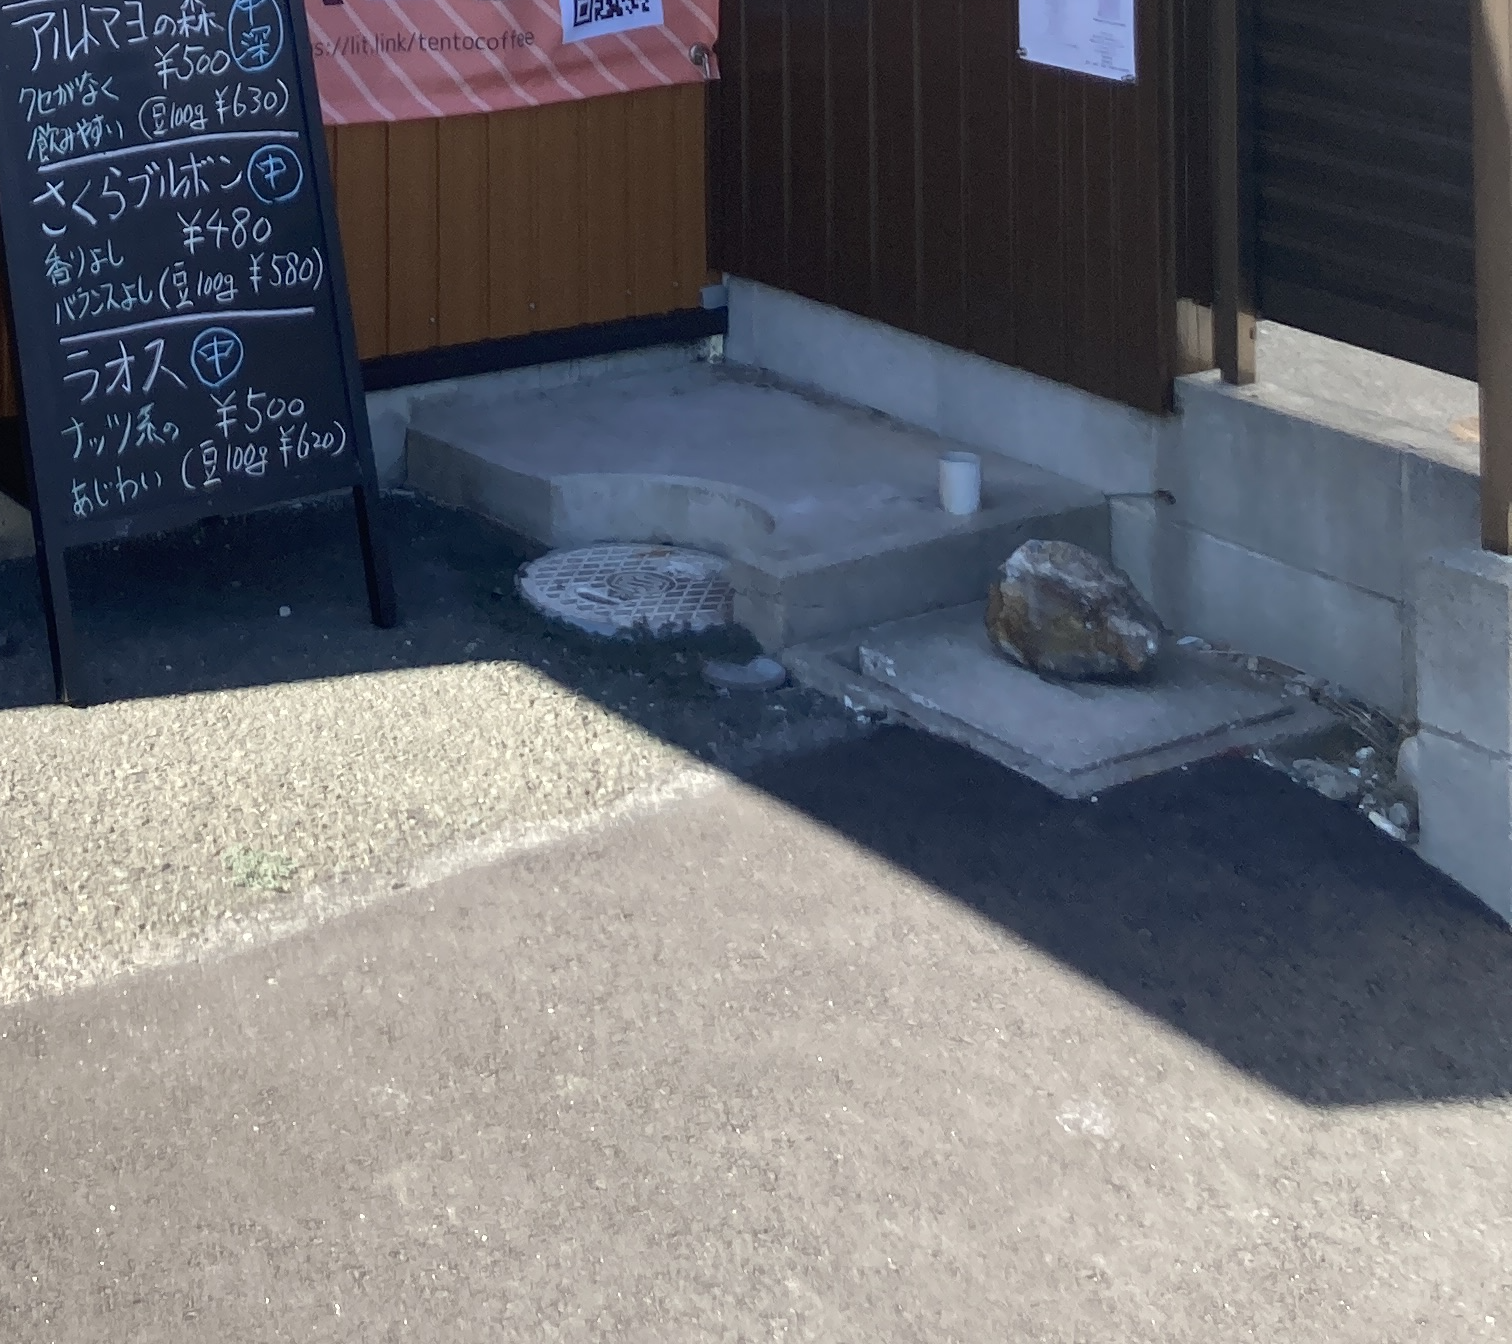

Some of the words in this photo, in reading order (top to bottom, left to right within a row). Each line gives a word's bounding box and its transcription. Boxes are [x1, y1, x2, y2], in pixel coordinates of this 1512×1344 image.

[155, 43, 230, 89] ¥500
[311, 30, 535, 59] s://lit.link/tentocoffee
[19, 70, 120, 123] クセがなく
[27, 115, 124, 162] 飲みやすい
[31, 153, 243, 236] さくらブルボン
[177, 207, 272, 254] ¥480
[44, 239, 124, 288] 香りよし
[55, 276, 154, 325] バランスよし
[62, 338, 187, 404] ラオス
[210, 388, 305, 439] ¥500
[71, 466, 162, 518] あじわい
